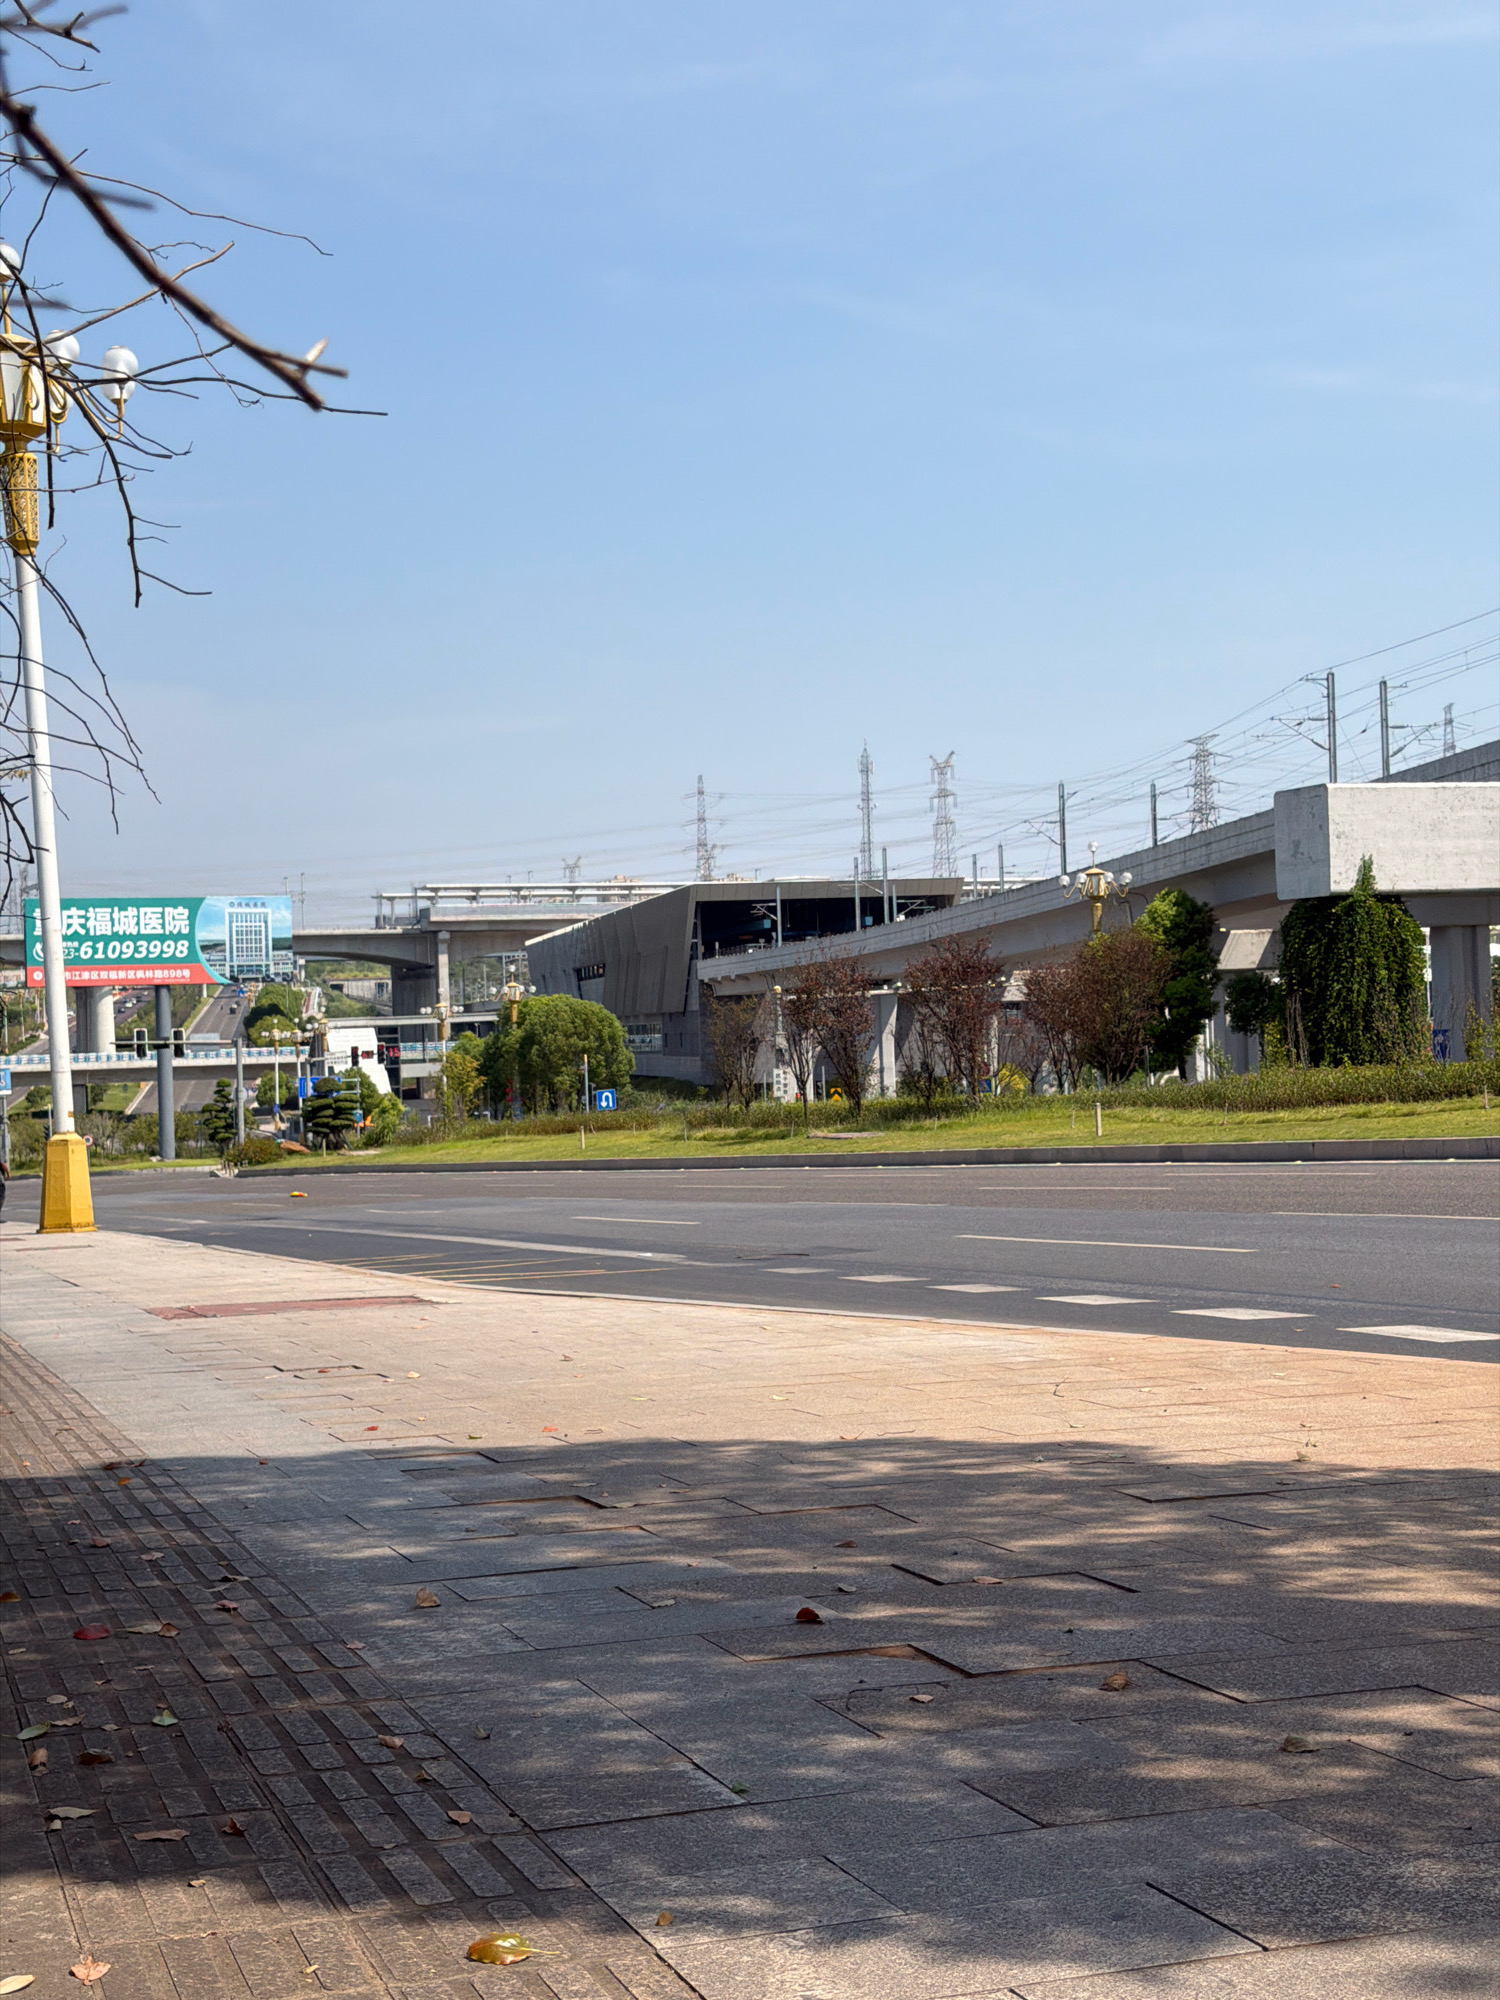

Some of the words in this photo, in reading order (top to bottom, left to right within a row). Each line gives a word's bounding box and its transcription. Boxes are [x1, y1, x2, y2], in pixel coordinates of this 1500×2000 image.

[62, 940, 189, 959] 23-61093998
[64, 969, 190, 980] 市江津区双福新区枫林路898号
